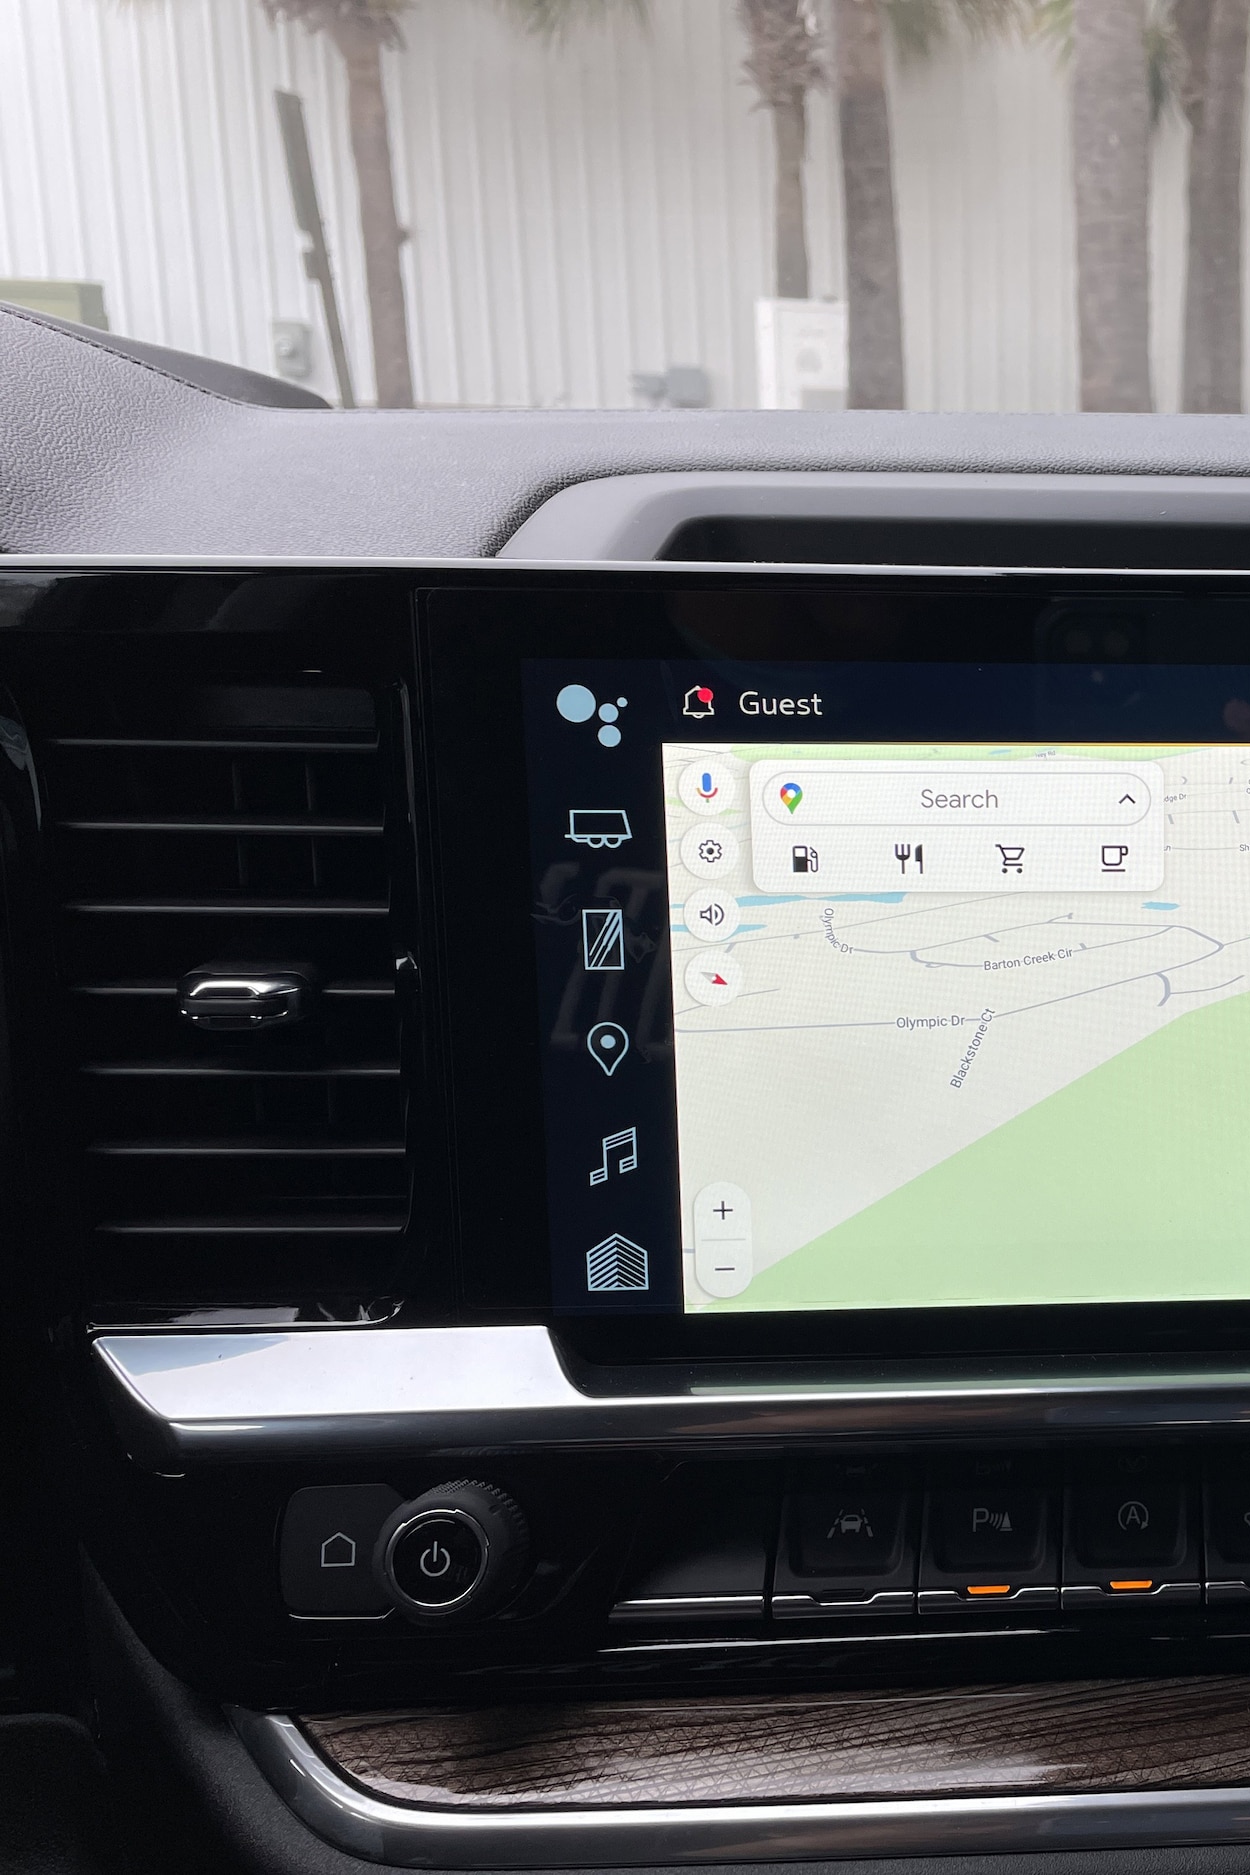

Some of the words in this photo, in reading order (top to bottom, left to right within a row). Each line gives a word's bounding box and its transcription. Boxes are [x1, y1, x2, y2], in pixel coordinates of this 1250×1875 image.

[739, 690, 823, 716] Guest
[920, 788, 998, 809] Search
[819, 907, 841, 949] Olympic
[840, 943, 854, 954] Dr
[983, 959, 1021, 971] Barton
[1023, 952, 1056, 966] Creek
[1057, 948, 1073, 960] Cir
[896, 1015, 948, 1031] Olympic
[950, 1015, 965, 1027] Dr
[950, 1023, 989, 1089] Blackstone
[981, 1007, 996, 1023] Ct
[972, 1507, 990, 1533] P
[1125, 1505, 1141, 1525] A
